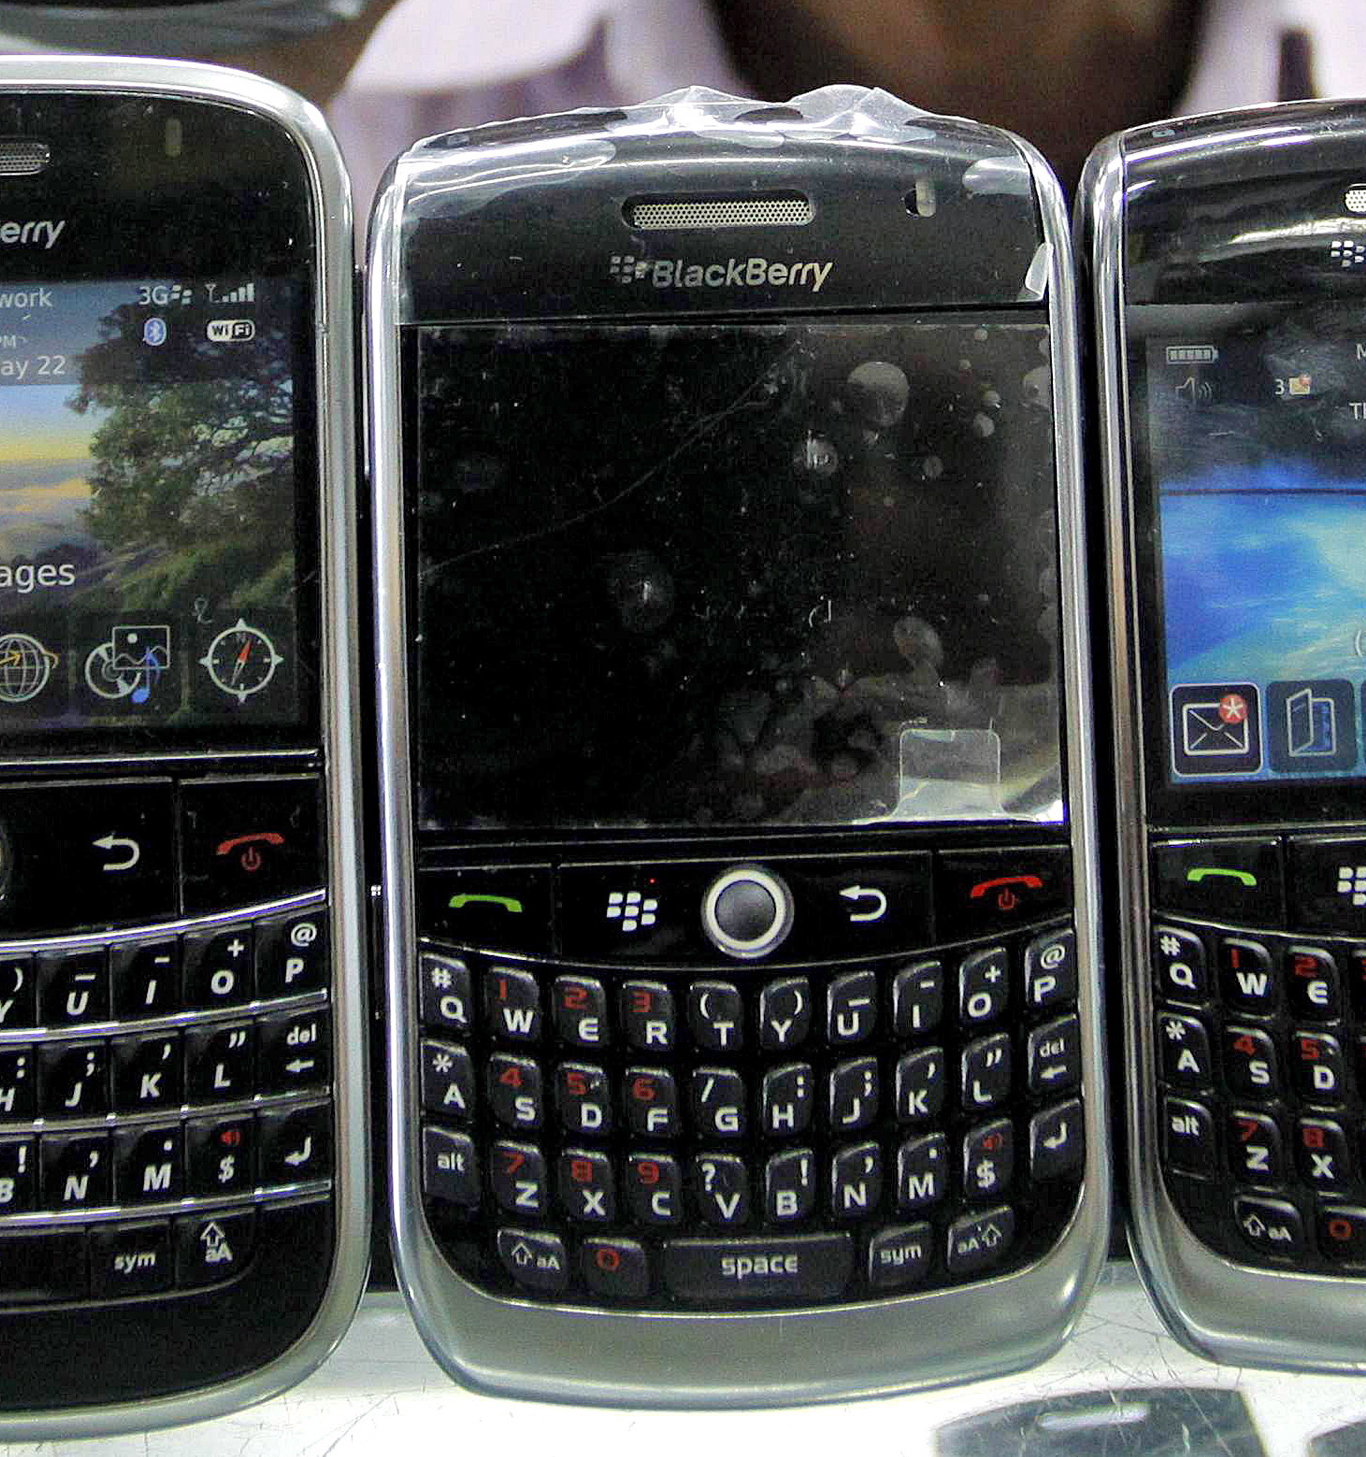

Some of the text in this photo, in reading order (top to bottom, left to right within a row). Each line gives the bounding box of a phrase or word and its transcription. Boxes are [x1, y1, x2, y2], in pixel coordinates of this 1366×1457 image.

[653, 258, 833, 292] BlackBerry
[138, 285, 169, 304] 3G
[36, 355, 65, 376] 22
[1274, 378, 1285, 397] 3
[66, 991, 89, 1016] U
[145, 980, 157, 1005] I
[210, 970, 235, 995] O
[285, 957, 305, 983] P
[287, 1024, 316, 1045] del
[1040, 1038, 1064, 1057] del
[64, 1082, 83, 1107] J
[140, 1072, 162, 1099] K
[214, 1063, 231, 1089] L
[1172, 1116, 1199, 1135] alt
[438, 1153, 464, 1171] alt
[63, 1175, 89, 1201] N
[142, 1163, 172, 1191] M
[115, 1253, 155, 1273] sym
[722, 1255, 798, 1279] space
[881, 1245, 921, 1265] sym
